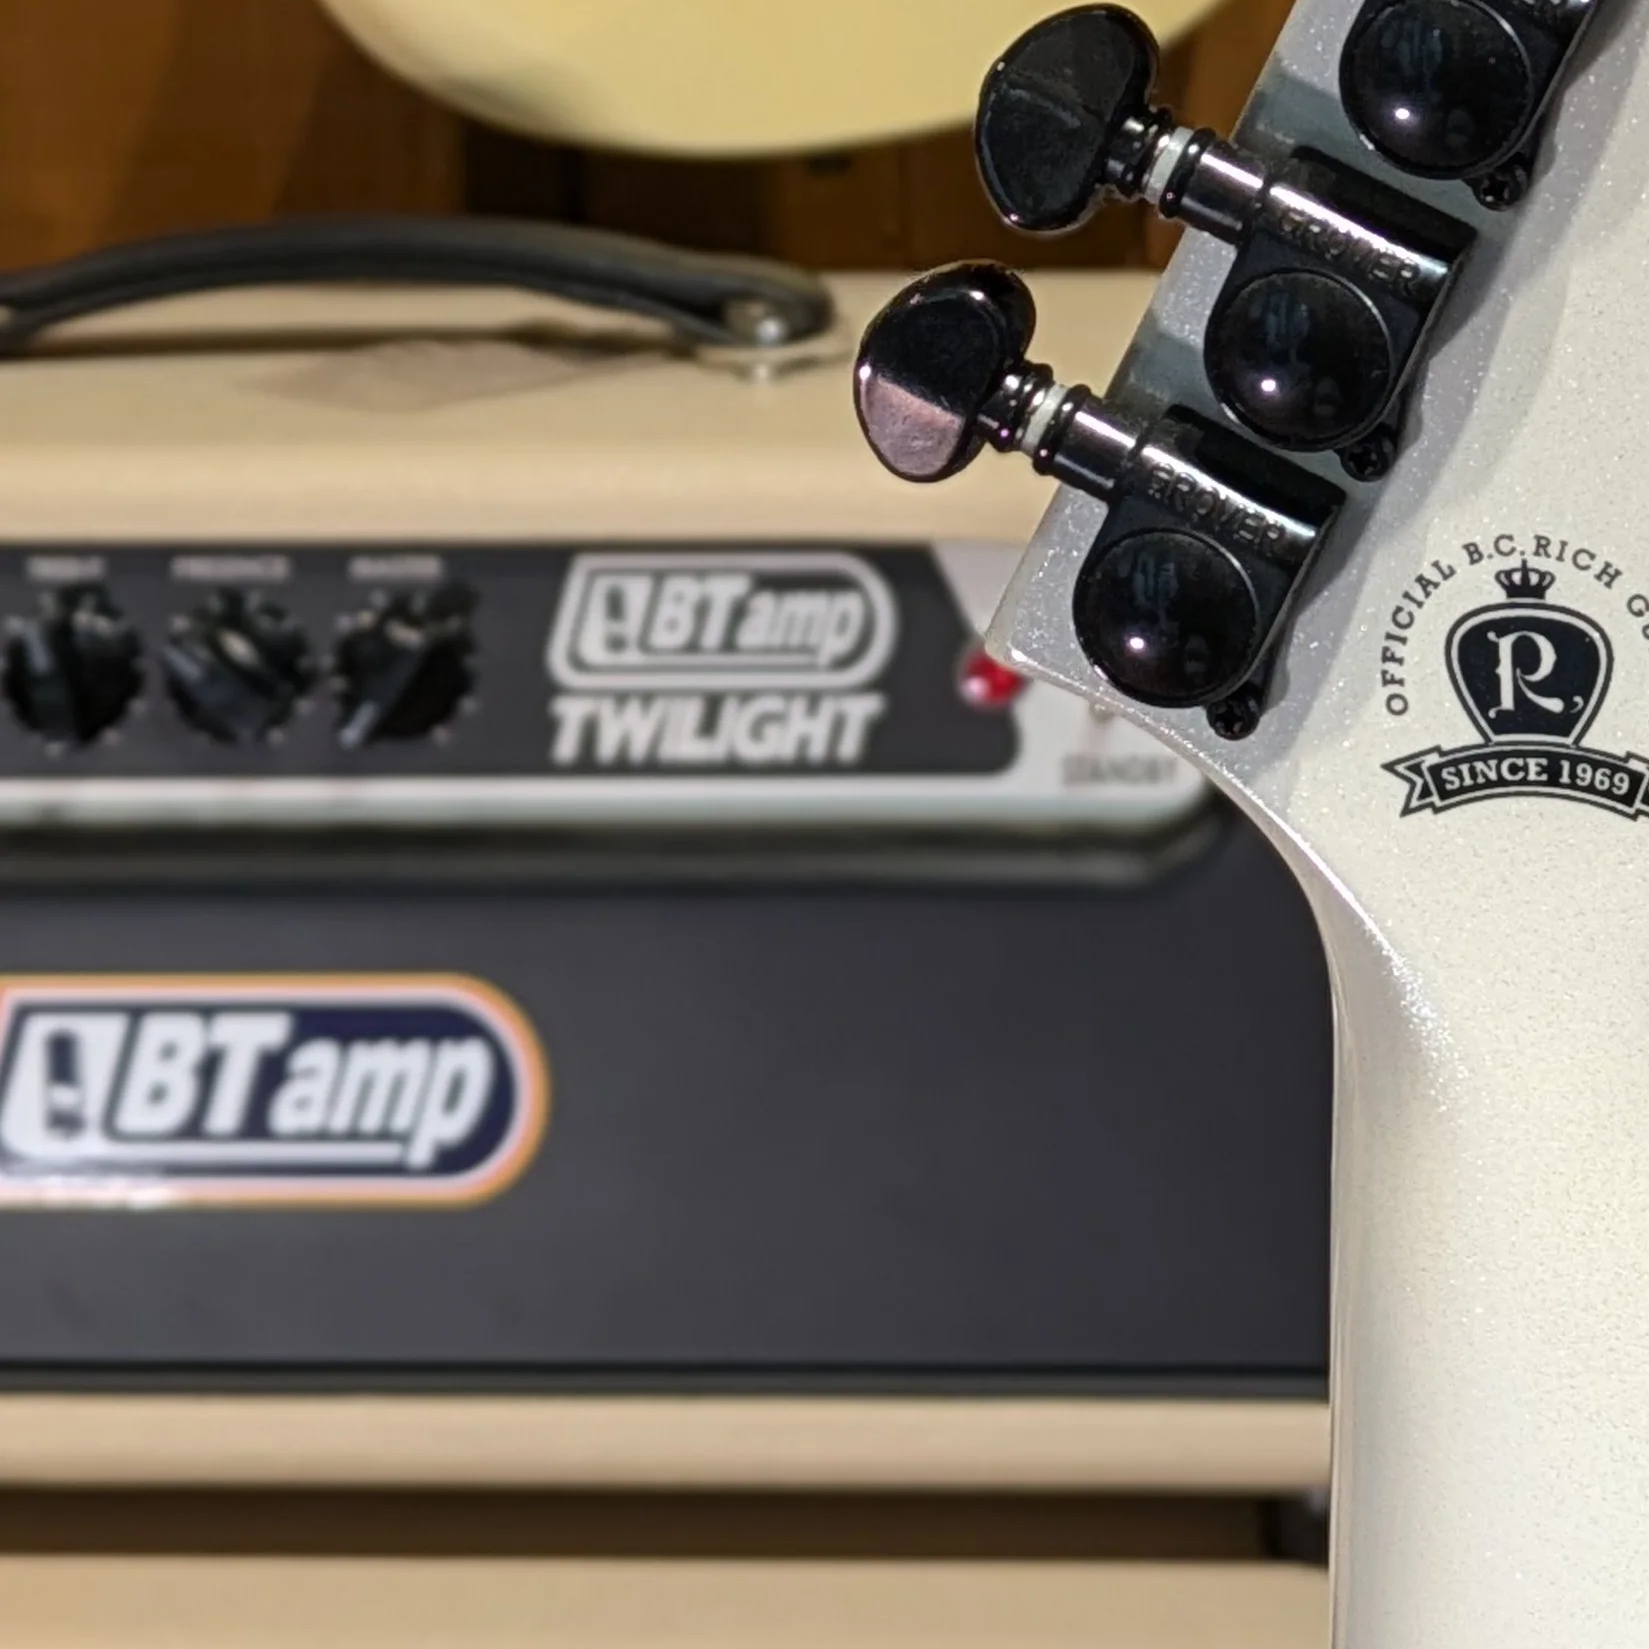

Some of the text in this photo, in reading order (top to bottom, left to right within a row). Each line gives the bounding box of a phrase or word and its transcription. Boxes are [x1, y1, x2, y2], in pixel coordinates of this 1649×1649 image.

[1380, 559, 1457, 717] OFFICIAL
[549, 693, 886, 765] TWILIGHT
[1440, 756, 1632, 797] SINCE 1969
